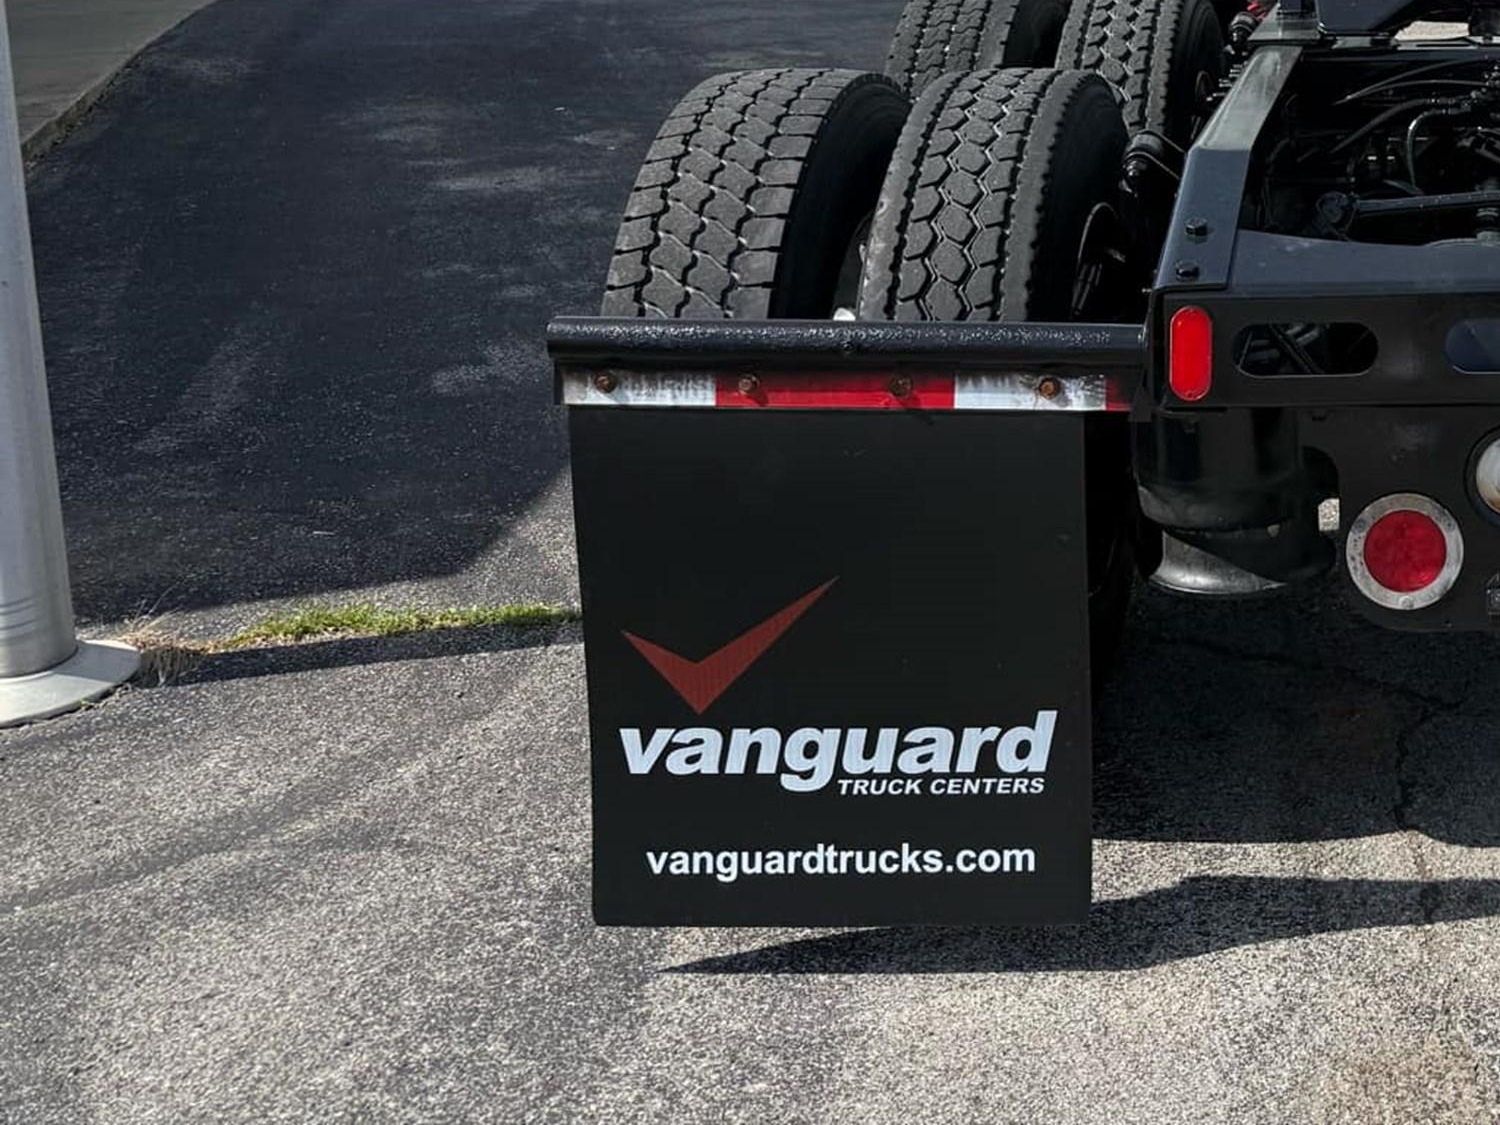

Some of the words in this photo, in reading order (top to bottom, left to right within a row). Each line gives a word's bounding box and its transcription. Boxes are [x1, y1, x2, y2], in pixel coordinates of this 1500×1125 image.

[619, 710, 1058, 792] vanguard
[837, 778, 922, 796] TRUCK
[930, 777, 1045, 795] CENTERS
[646, 843, 1036, 883] vanguardtrucks.com
